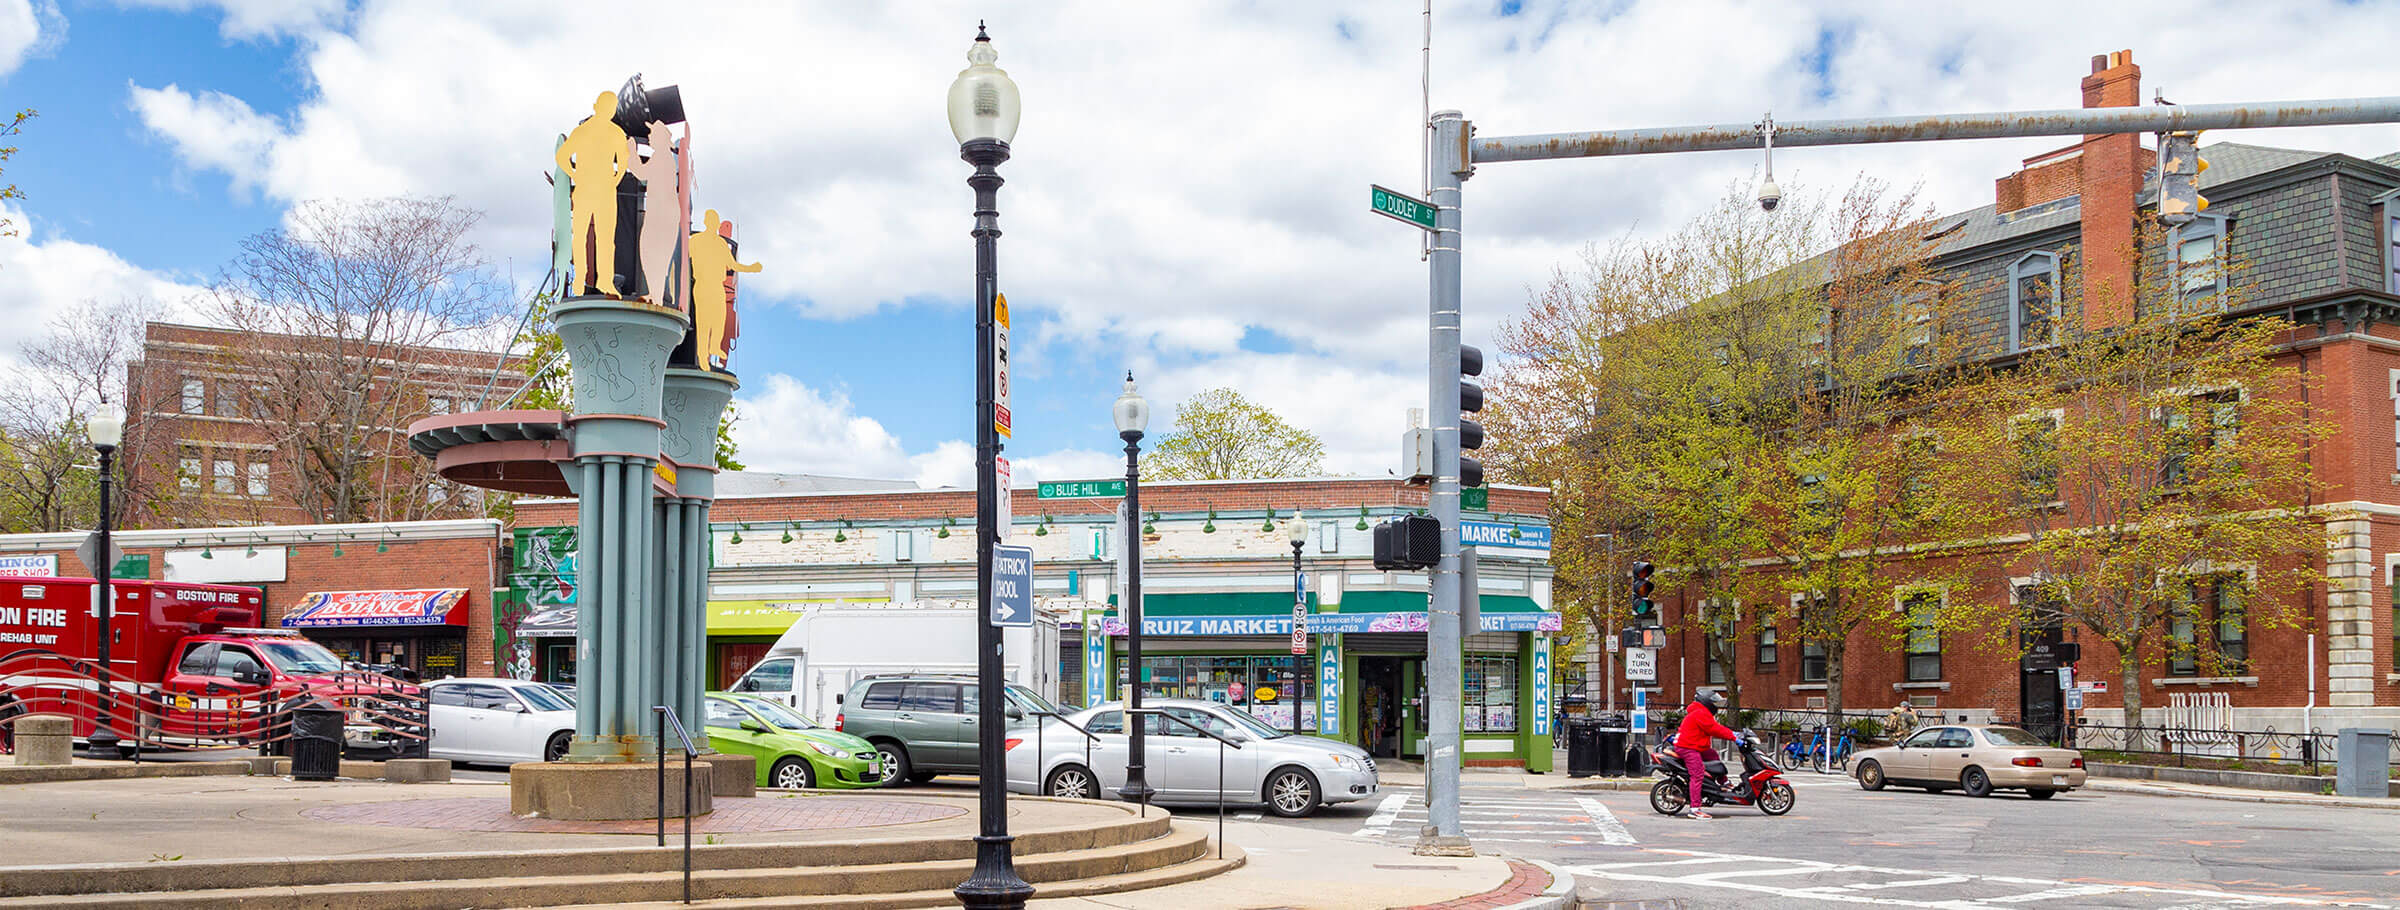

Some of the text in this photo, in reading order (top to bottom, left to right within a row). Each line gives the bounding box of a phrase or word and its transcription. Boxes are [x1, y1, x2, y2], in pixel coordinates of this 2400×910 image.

[1388, 195, 1433, 220] DUDLEY ST
[1056, 482, 1121, 496] BLUE HILL AVE
[0, 558, 47, 568] INGO
[176, 590, 239, 603] BOSTON FIRE
[322, 600, 421, 614] BOTANICA
[27, 608, 67, 627] FIRE
[1351, 615, 1365, 623] Food
[1479, 616, 1505, 630] RKET
[1143, 619, 1292, 634] RUIZ MARKET
[0, 632, 58, 645] REHAB UNIT
[1322, 632, 1337, 731] MARKET
[1536, 639, 1546, 733] MARKET
